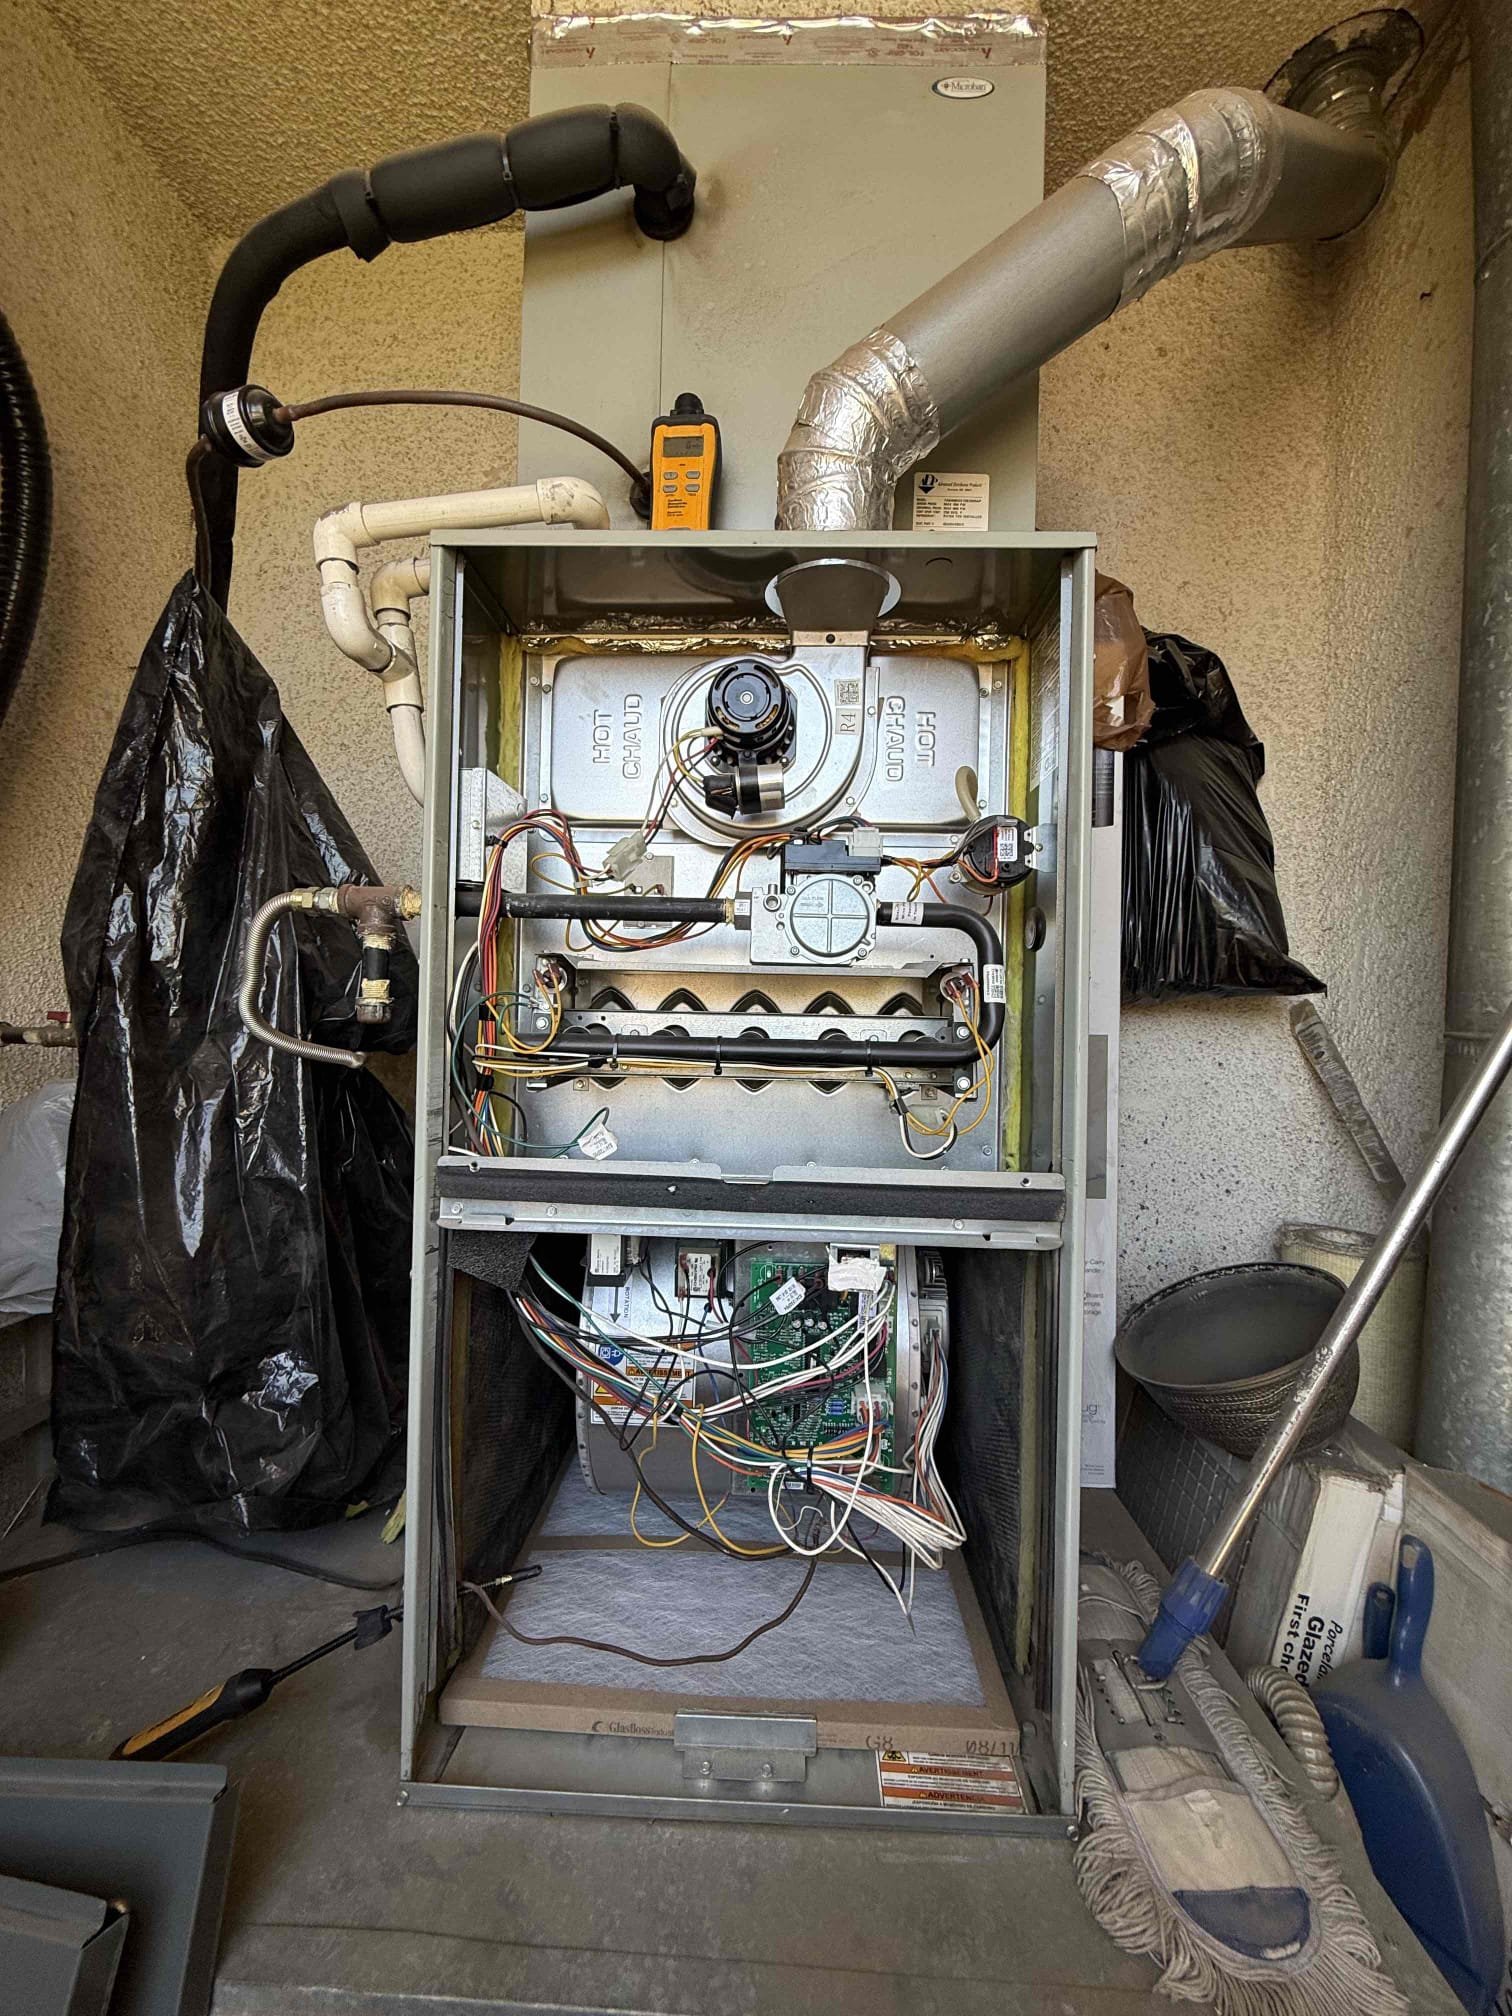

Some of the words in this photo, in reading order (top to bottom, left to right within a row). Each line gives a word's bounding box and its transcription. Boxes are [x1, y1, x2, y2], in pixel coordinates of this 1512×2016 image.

[592, 708, 613, 764] HOT
[622, 693, 643, 780] CHAUD
[839, 712, 857, 733] R4
[885, 695, 906, 782] CHAUD
[916, 711, 937, 767] HOT
[623, 1286, 632, 1319] ROTATION
[1287, 1593, 1311, 1639] First
[1295, 1615, 1325, 1688] Glazed
[865, 1735, 894, 1751] G8
